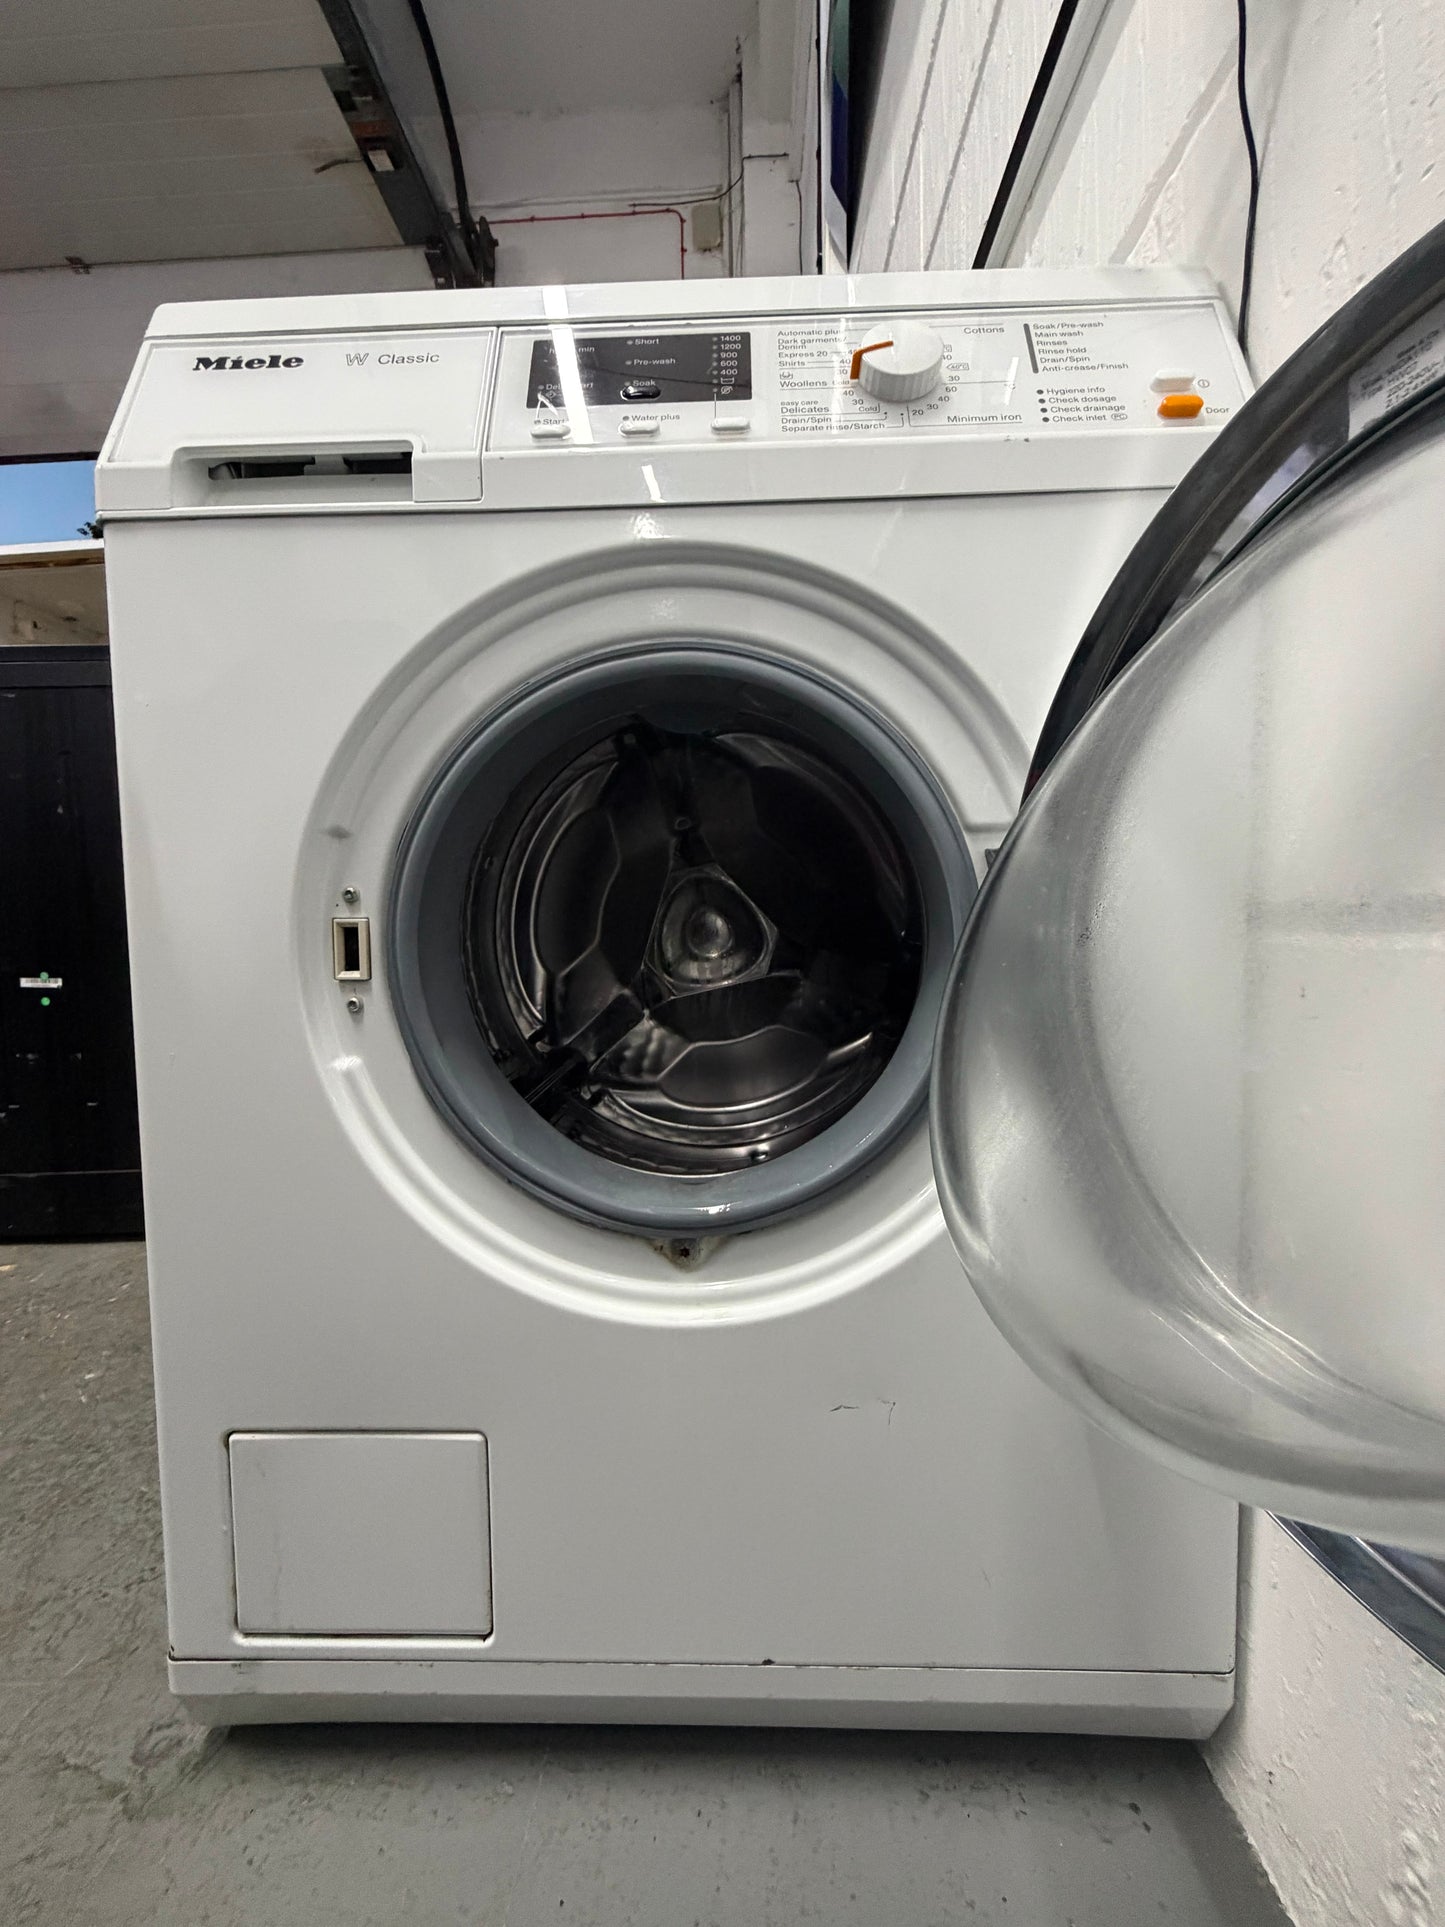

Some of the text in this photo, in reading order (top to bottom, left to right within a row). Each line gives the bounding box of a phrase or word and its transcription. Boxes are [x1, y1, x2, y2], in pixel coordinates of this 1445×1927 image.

[1033, 322, 1104, 330] Soak/Pre-wash
[777, 329, 823, 337] Automatic
[192, 355, 304, 371] Miele
[345, 352, 440, 366] W Classic
[633, 358, 676, 366] Pre-wash
[1040, 356, 1091, 364] Drain/Spin
[1042, 363, 1129, 372] Anti-crease/Finish
[1046, 387, 1085, 396] Hygiene
[1048, 395, 1117, 404] Check dosage
[780, 406, 830, 414] Delicates
[632, 413, 680, 422] Water plus
[947, 415, 998, 423] Minimum
[781, 424, 824, 432] Separate
